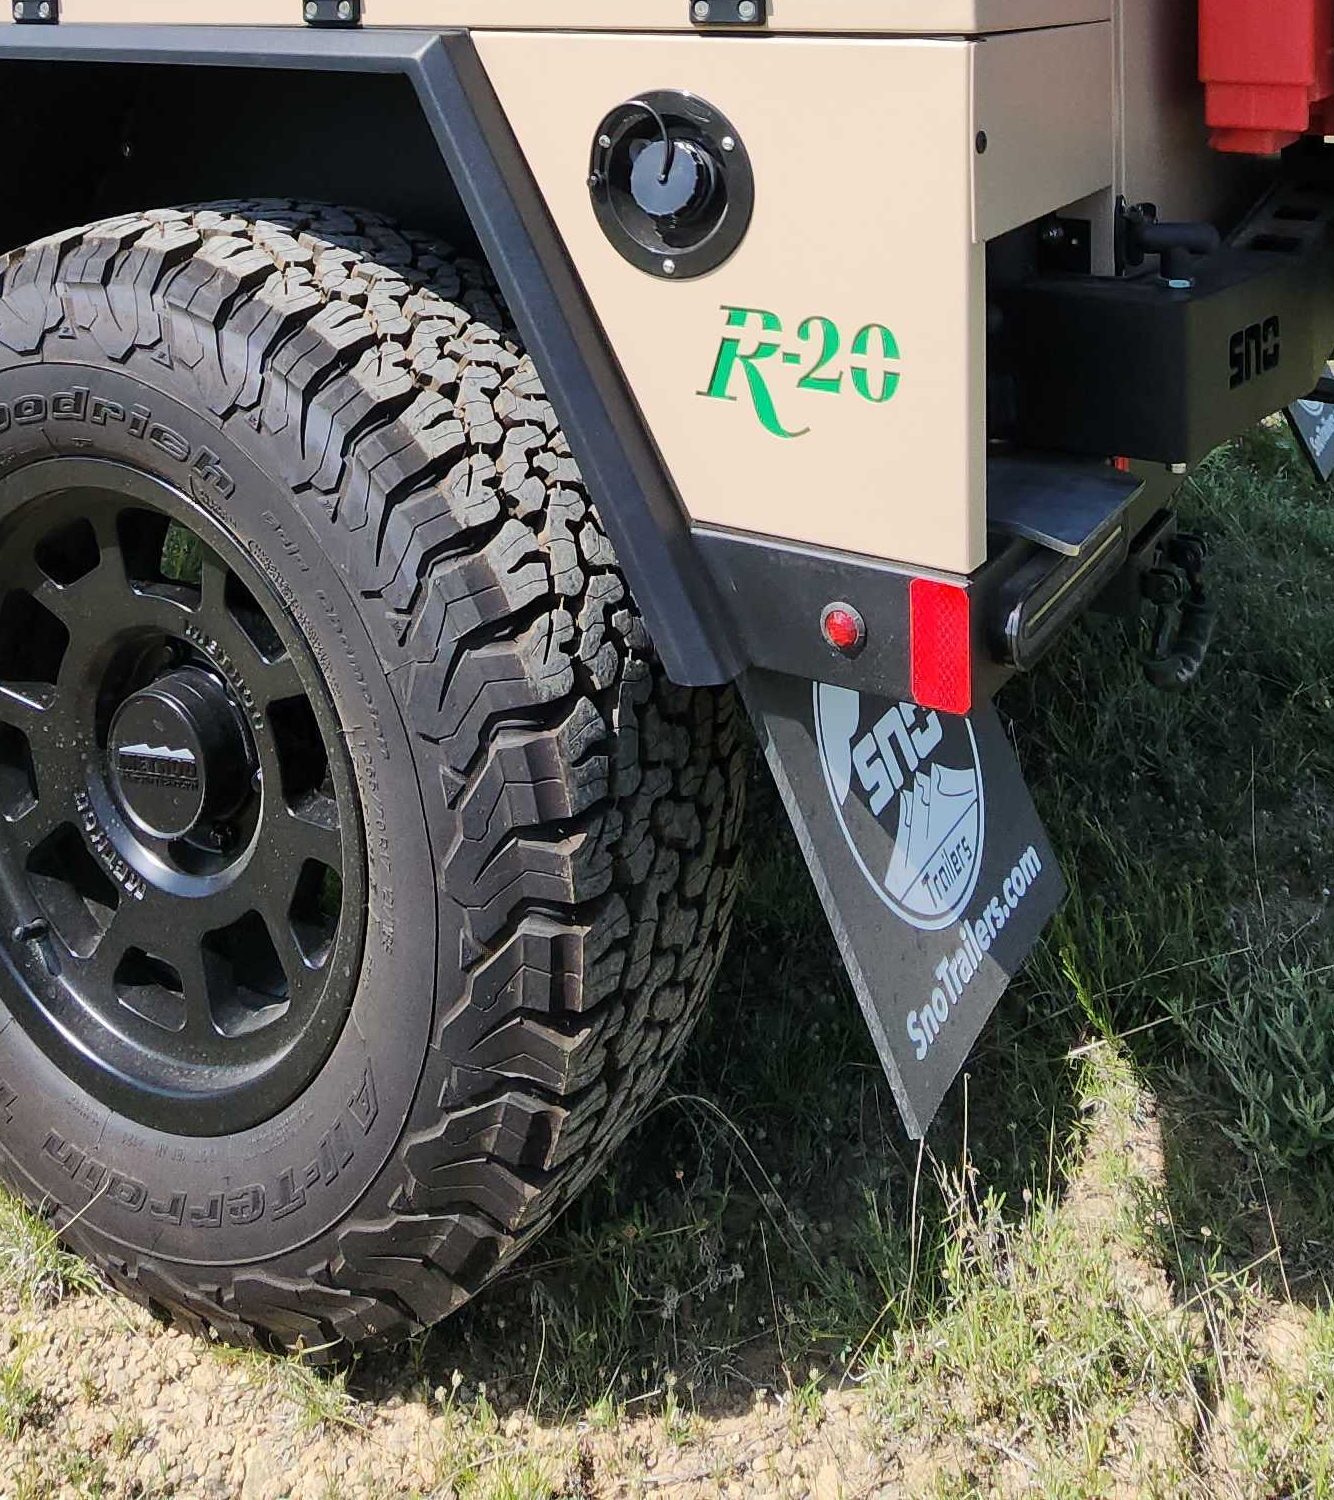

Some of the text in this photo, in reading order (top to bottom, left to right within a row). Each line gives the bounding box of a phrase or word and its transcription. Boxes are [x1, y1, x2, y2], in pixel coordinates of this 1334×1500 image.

[695, 305, 900, 439] R-20
[921, 836, 973, 909] Trailers
[907, 844, 1042, 1061] SnoTrailers.com
